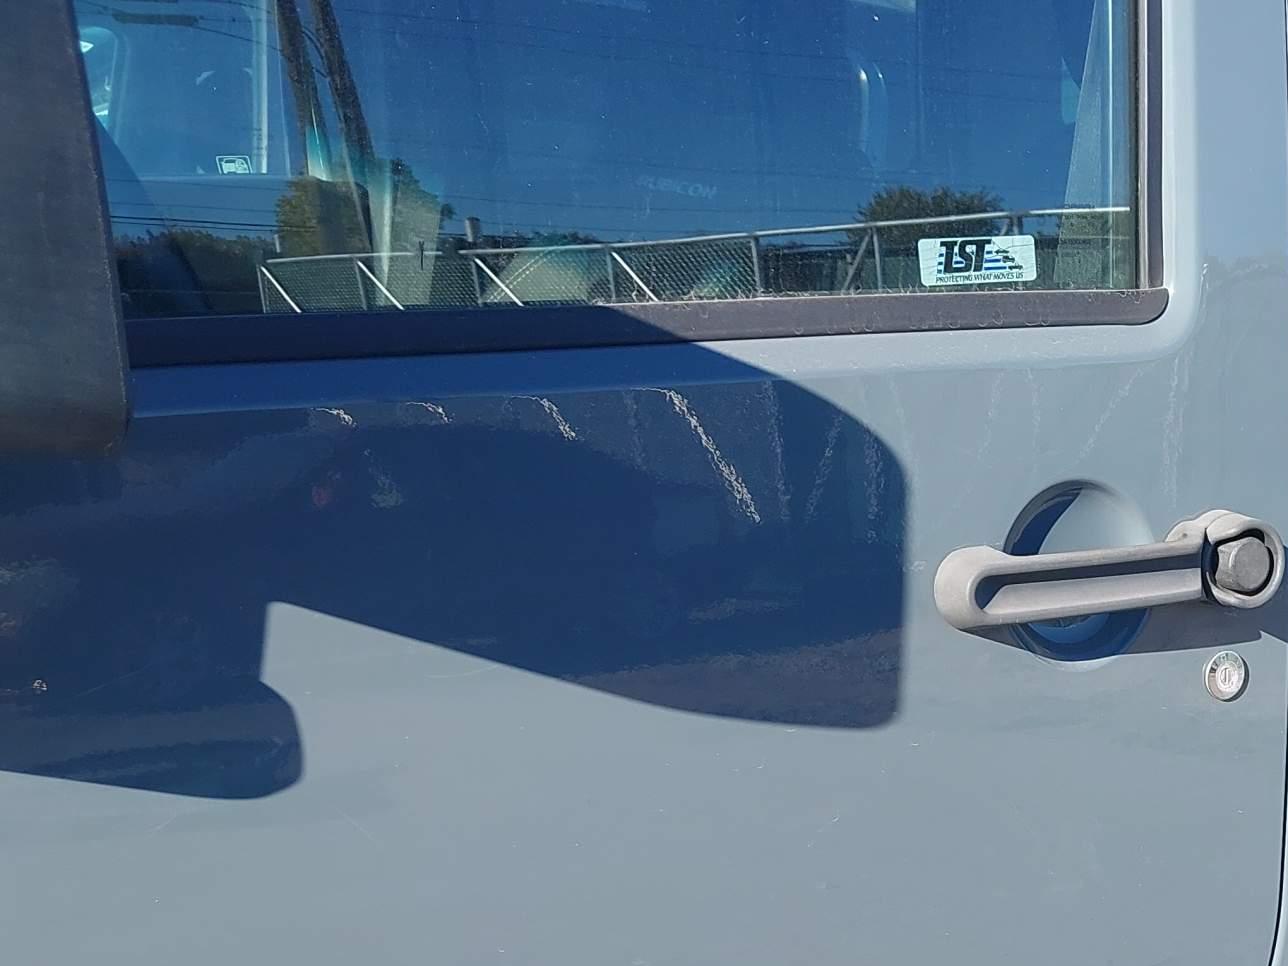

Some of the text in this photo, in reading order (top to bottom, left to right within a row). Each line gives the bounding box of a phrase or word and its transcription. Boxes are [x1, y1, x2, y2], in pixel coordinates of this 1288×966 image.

[935, 271, 1024, 284] PROTECTING WHAT MOVES US
